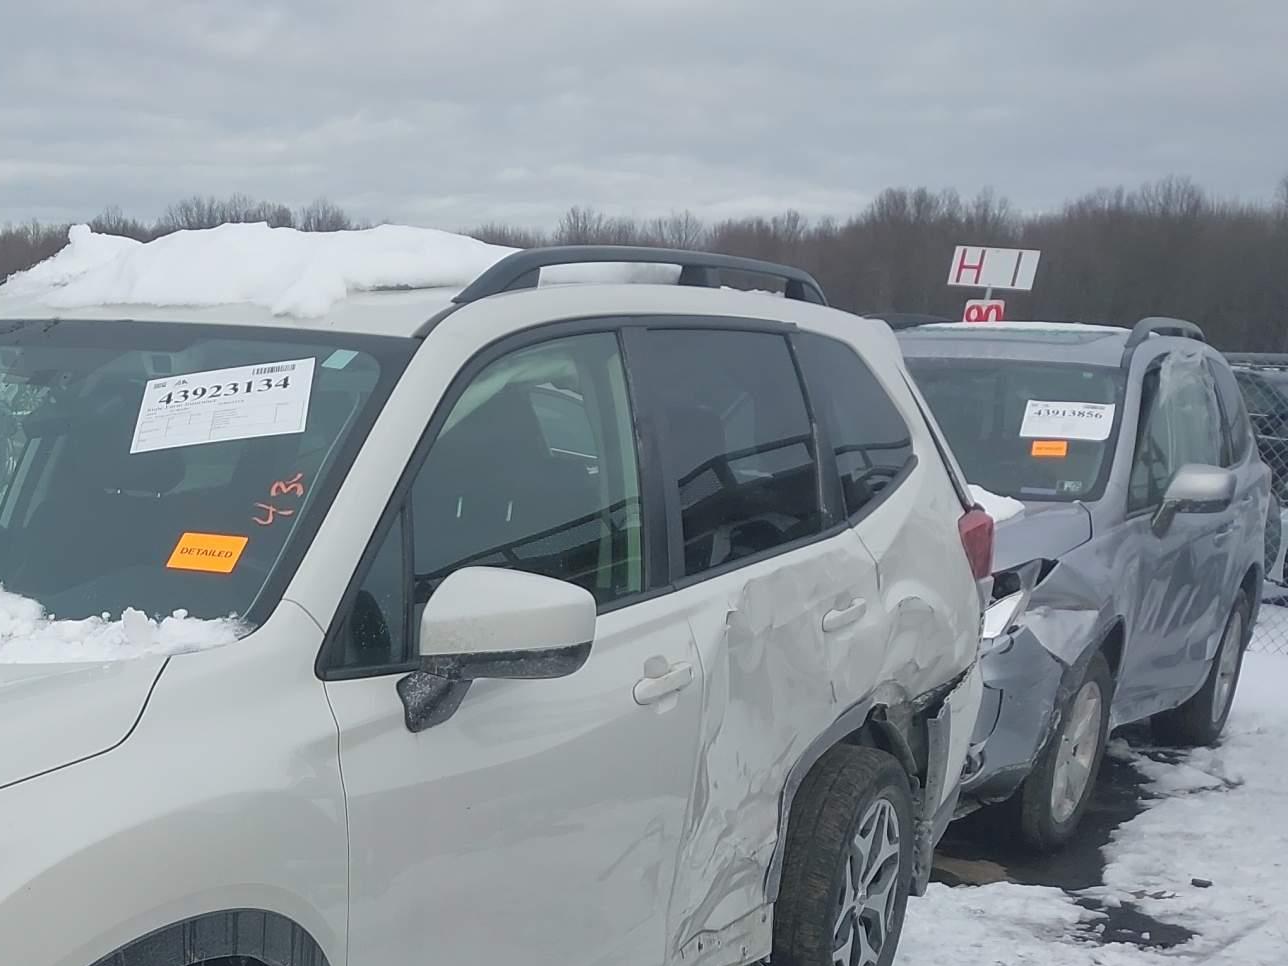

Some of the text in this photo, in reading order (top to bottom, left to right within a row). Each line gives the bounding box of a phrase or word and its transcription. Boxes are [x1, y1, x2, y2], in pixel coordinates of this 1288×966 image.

[955, 248, 987, 284] H
[158, 376, 291, 405] 43923134
[1033, 409, 1103, 419] 43913856
[179, 547, 233, 558] DETAILED
